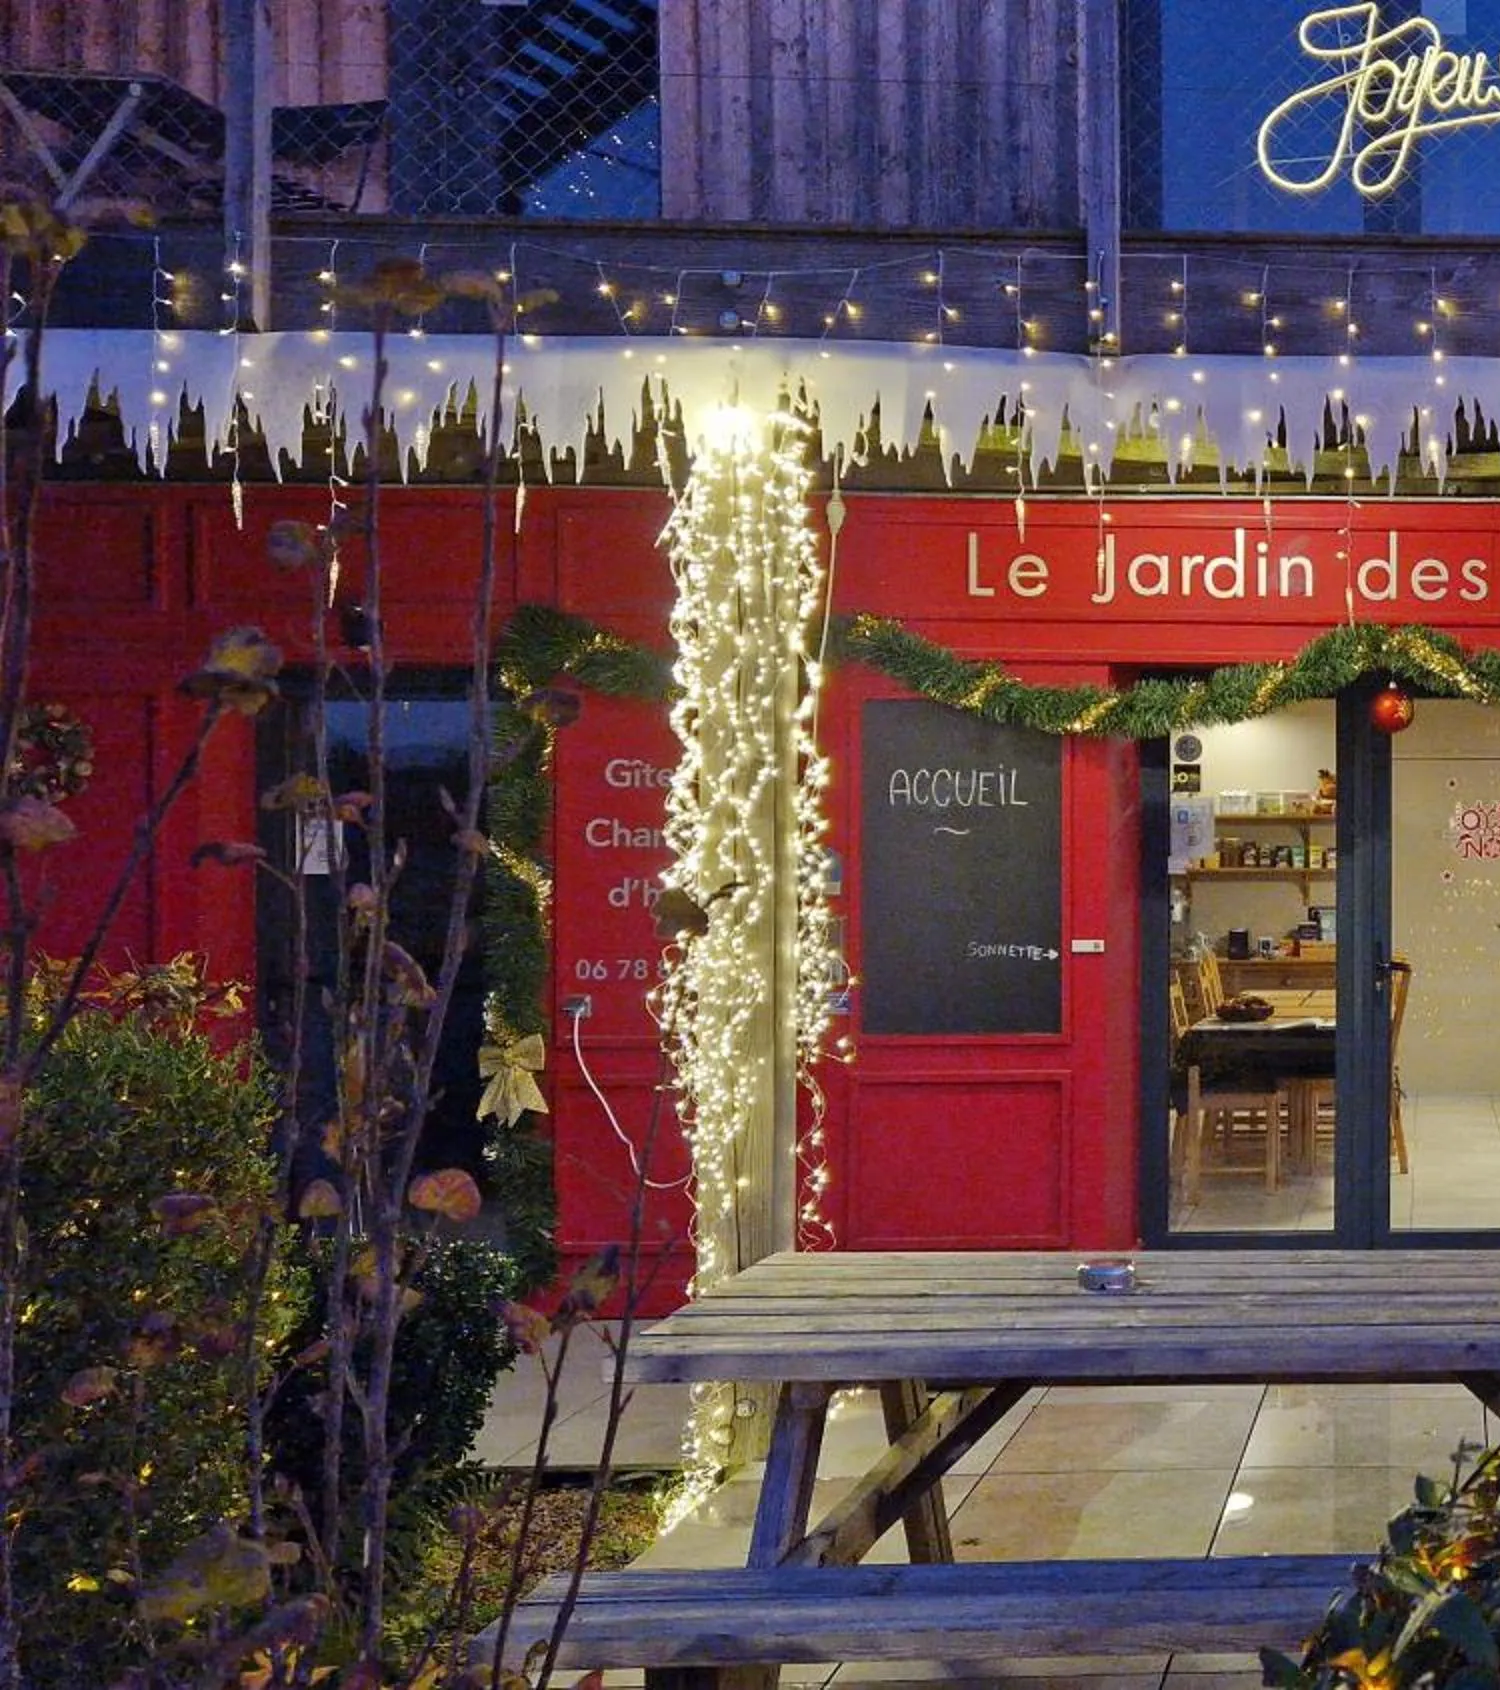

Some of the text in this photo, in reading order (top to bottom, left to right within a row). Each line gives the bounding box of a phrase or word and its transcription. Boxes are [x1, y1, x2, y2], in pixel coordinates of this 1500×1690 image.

[967, 531, 1050, 598] Le
[1091, 527, 1314, 604] Jardin
[1357, 530, 1489, 601] des
[575, 959, 608, 980] 06
[616, 959, 649, 980] 78
